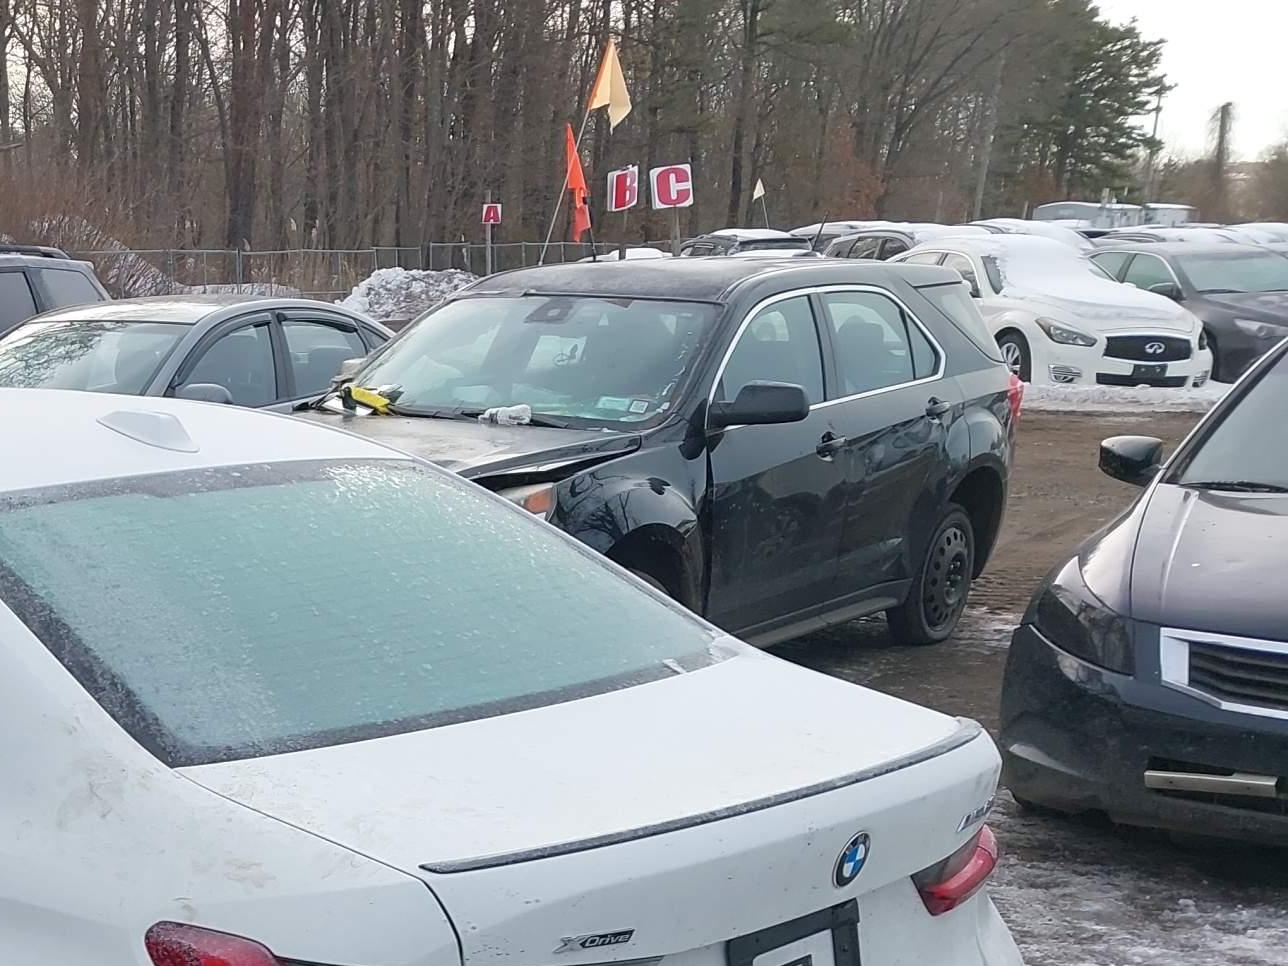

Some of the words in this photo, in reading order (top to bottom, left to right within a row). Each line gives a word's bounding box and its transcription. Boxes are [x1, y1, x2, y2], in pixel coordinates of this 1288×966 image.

[614, 169, 637, 209] B
[656, 167, 691, 206] C
[483, 205, 500, 223] A
